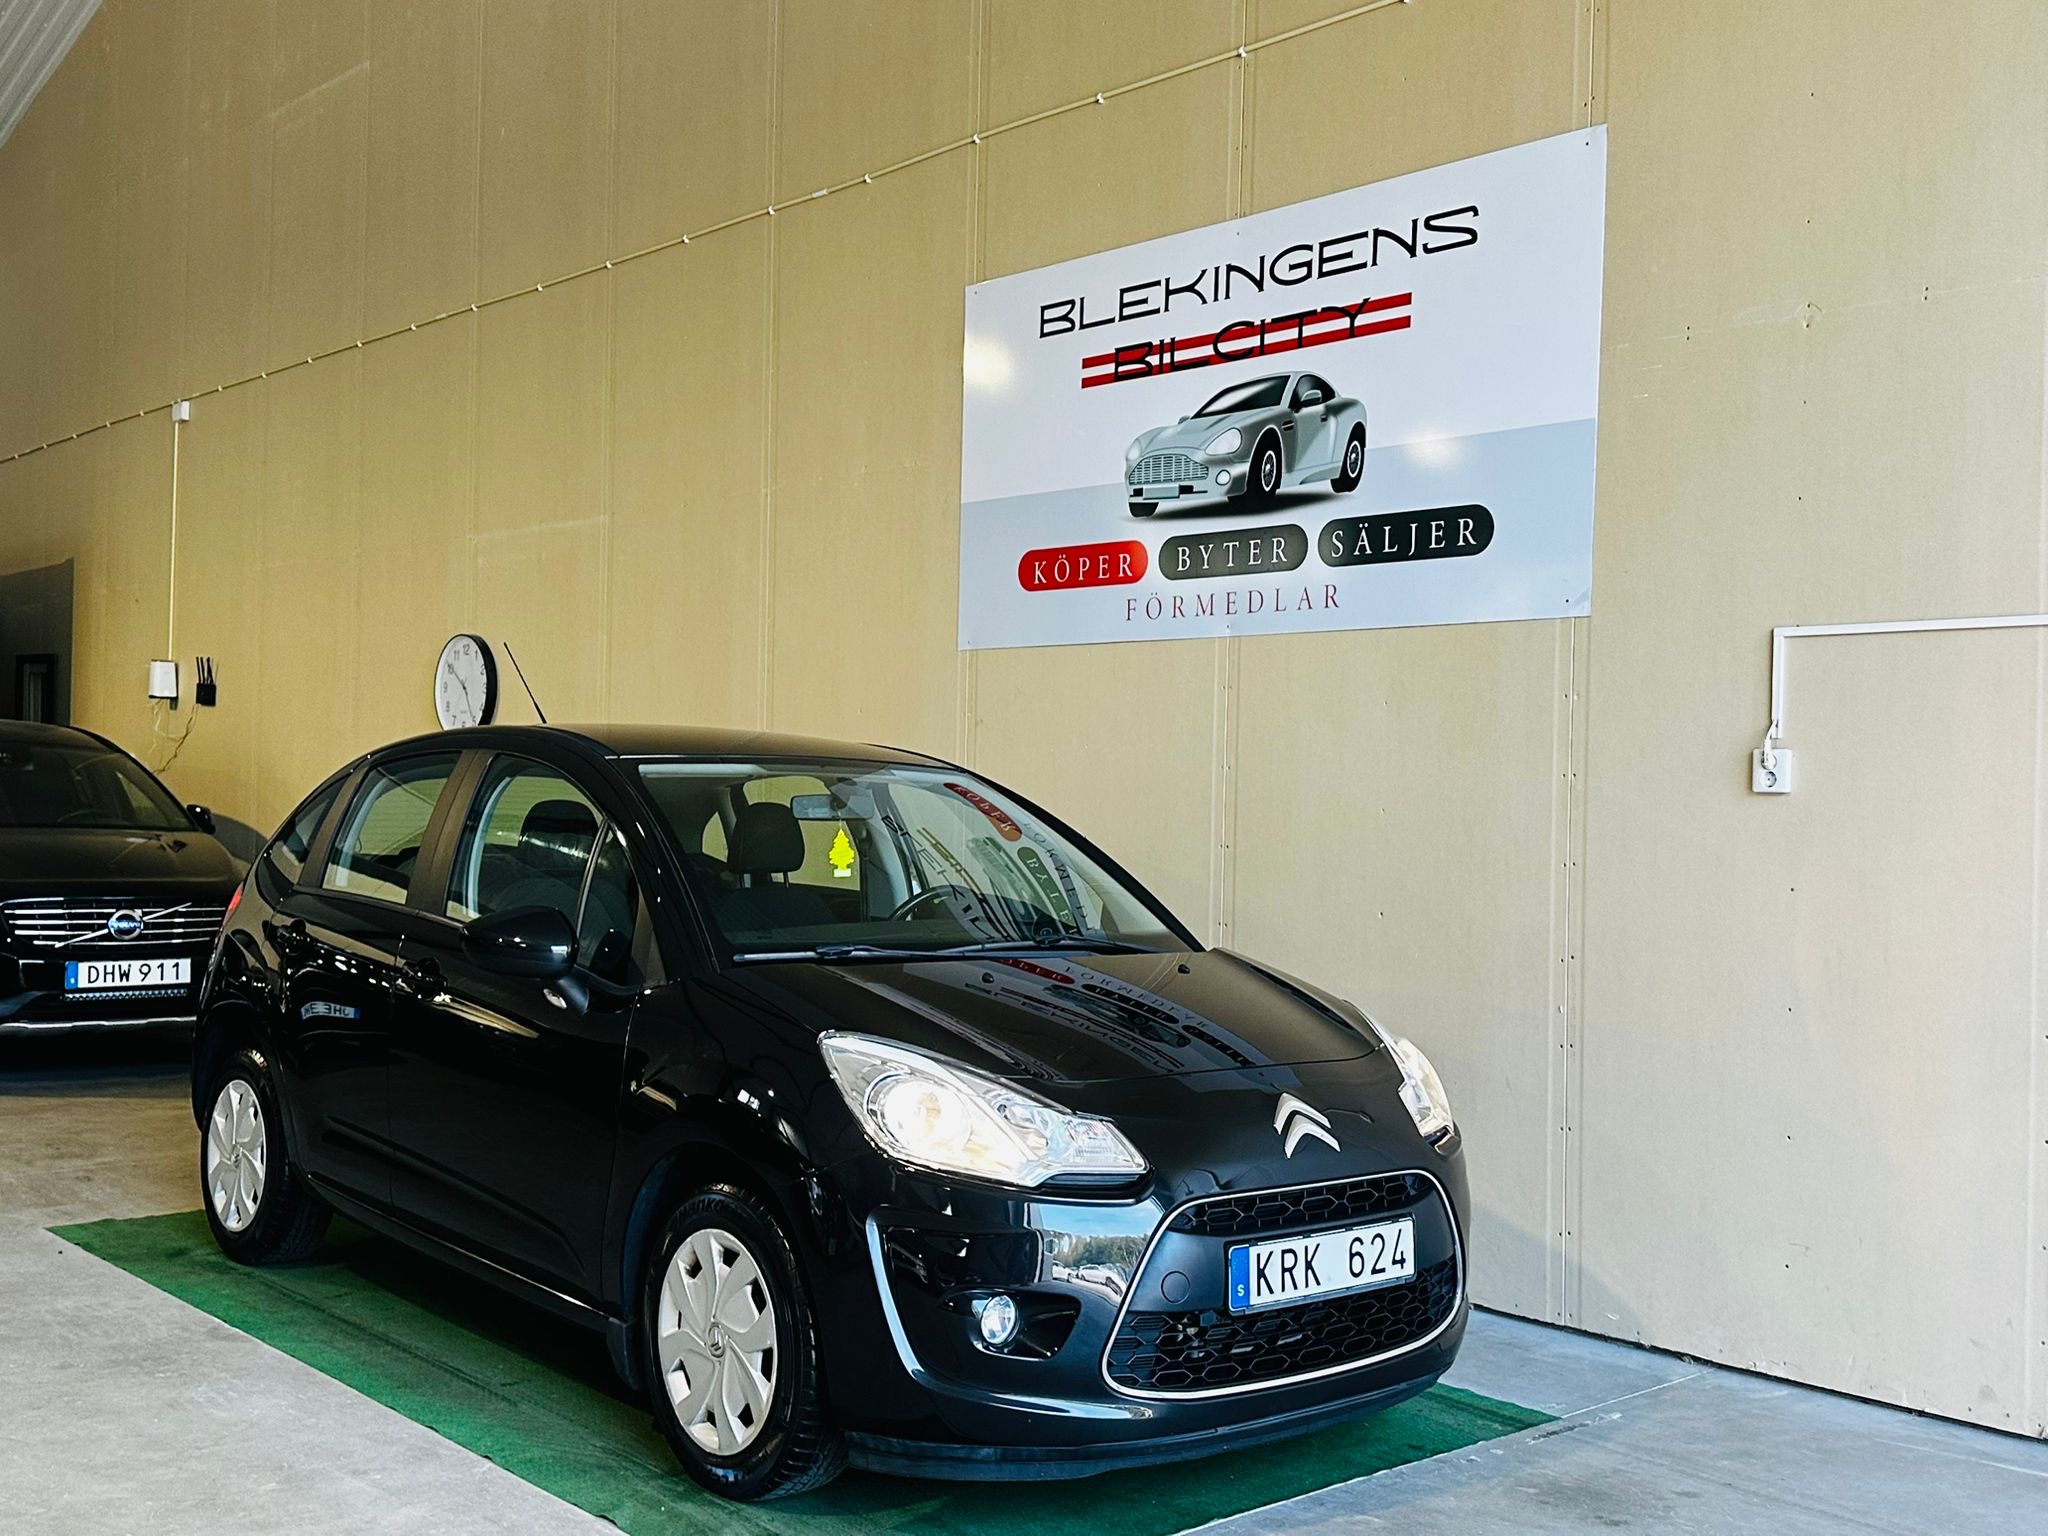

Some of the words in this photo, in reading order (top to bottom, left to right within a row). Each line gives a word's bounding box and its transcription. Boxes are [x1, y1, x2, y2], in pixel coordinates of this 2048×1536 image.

[1039, 205, 1480, 339] BLEKINGENS
[1113, 297, 1371, 382] BILCITY
[1033, 553, 1133, 585] KÖPER
[1176, 537, 1288, 572] BYTER
[1331, 518, 1478, 558] SÄLJER
[1125, 584, 1340, 621] FÖRMEDLAR
[87, 963, 132, 984] DHW
[138, 961, 180, 982] 911
[1237, 1283, 1245, 1297] S
[1255, 1242, 1322, 1297] KRK
[1348, 1227, 1407, 1279] 624
